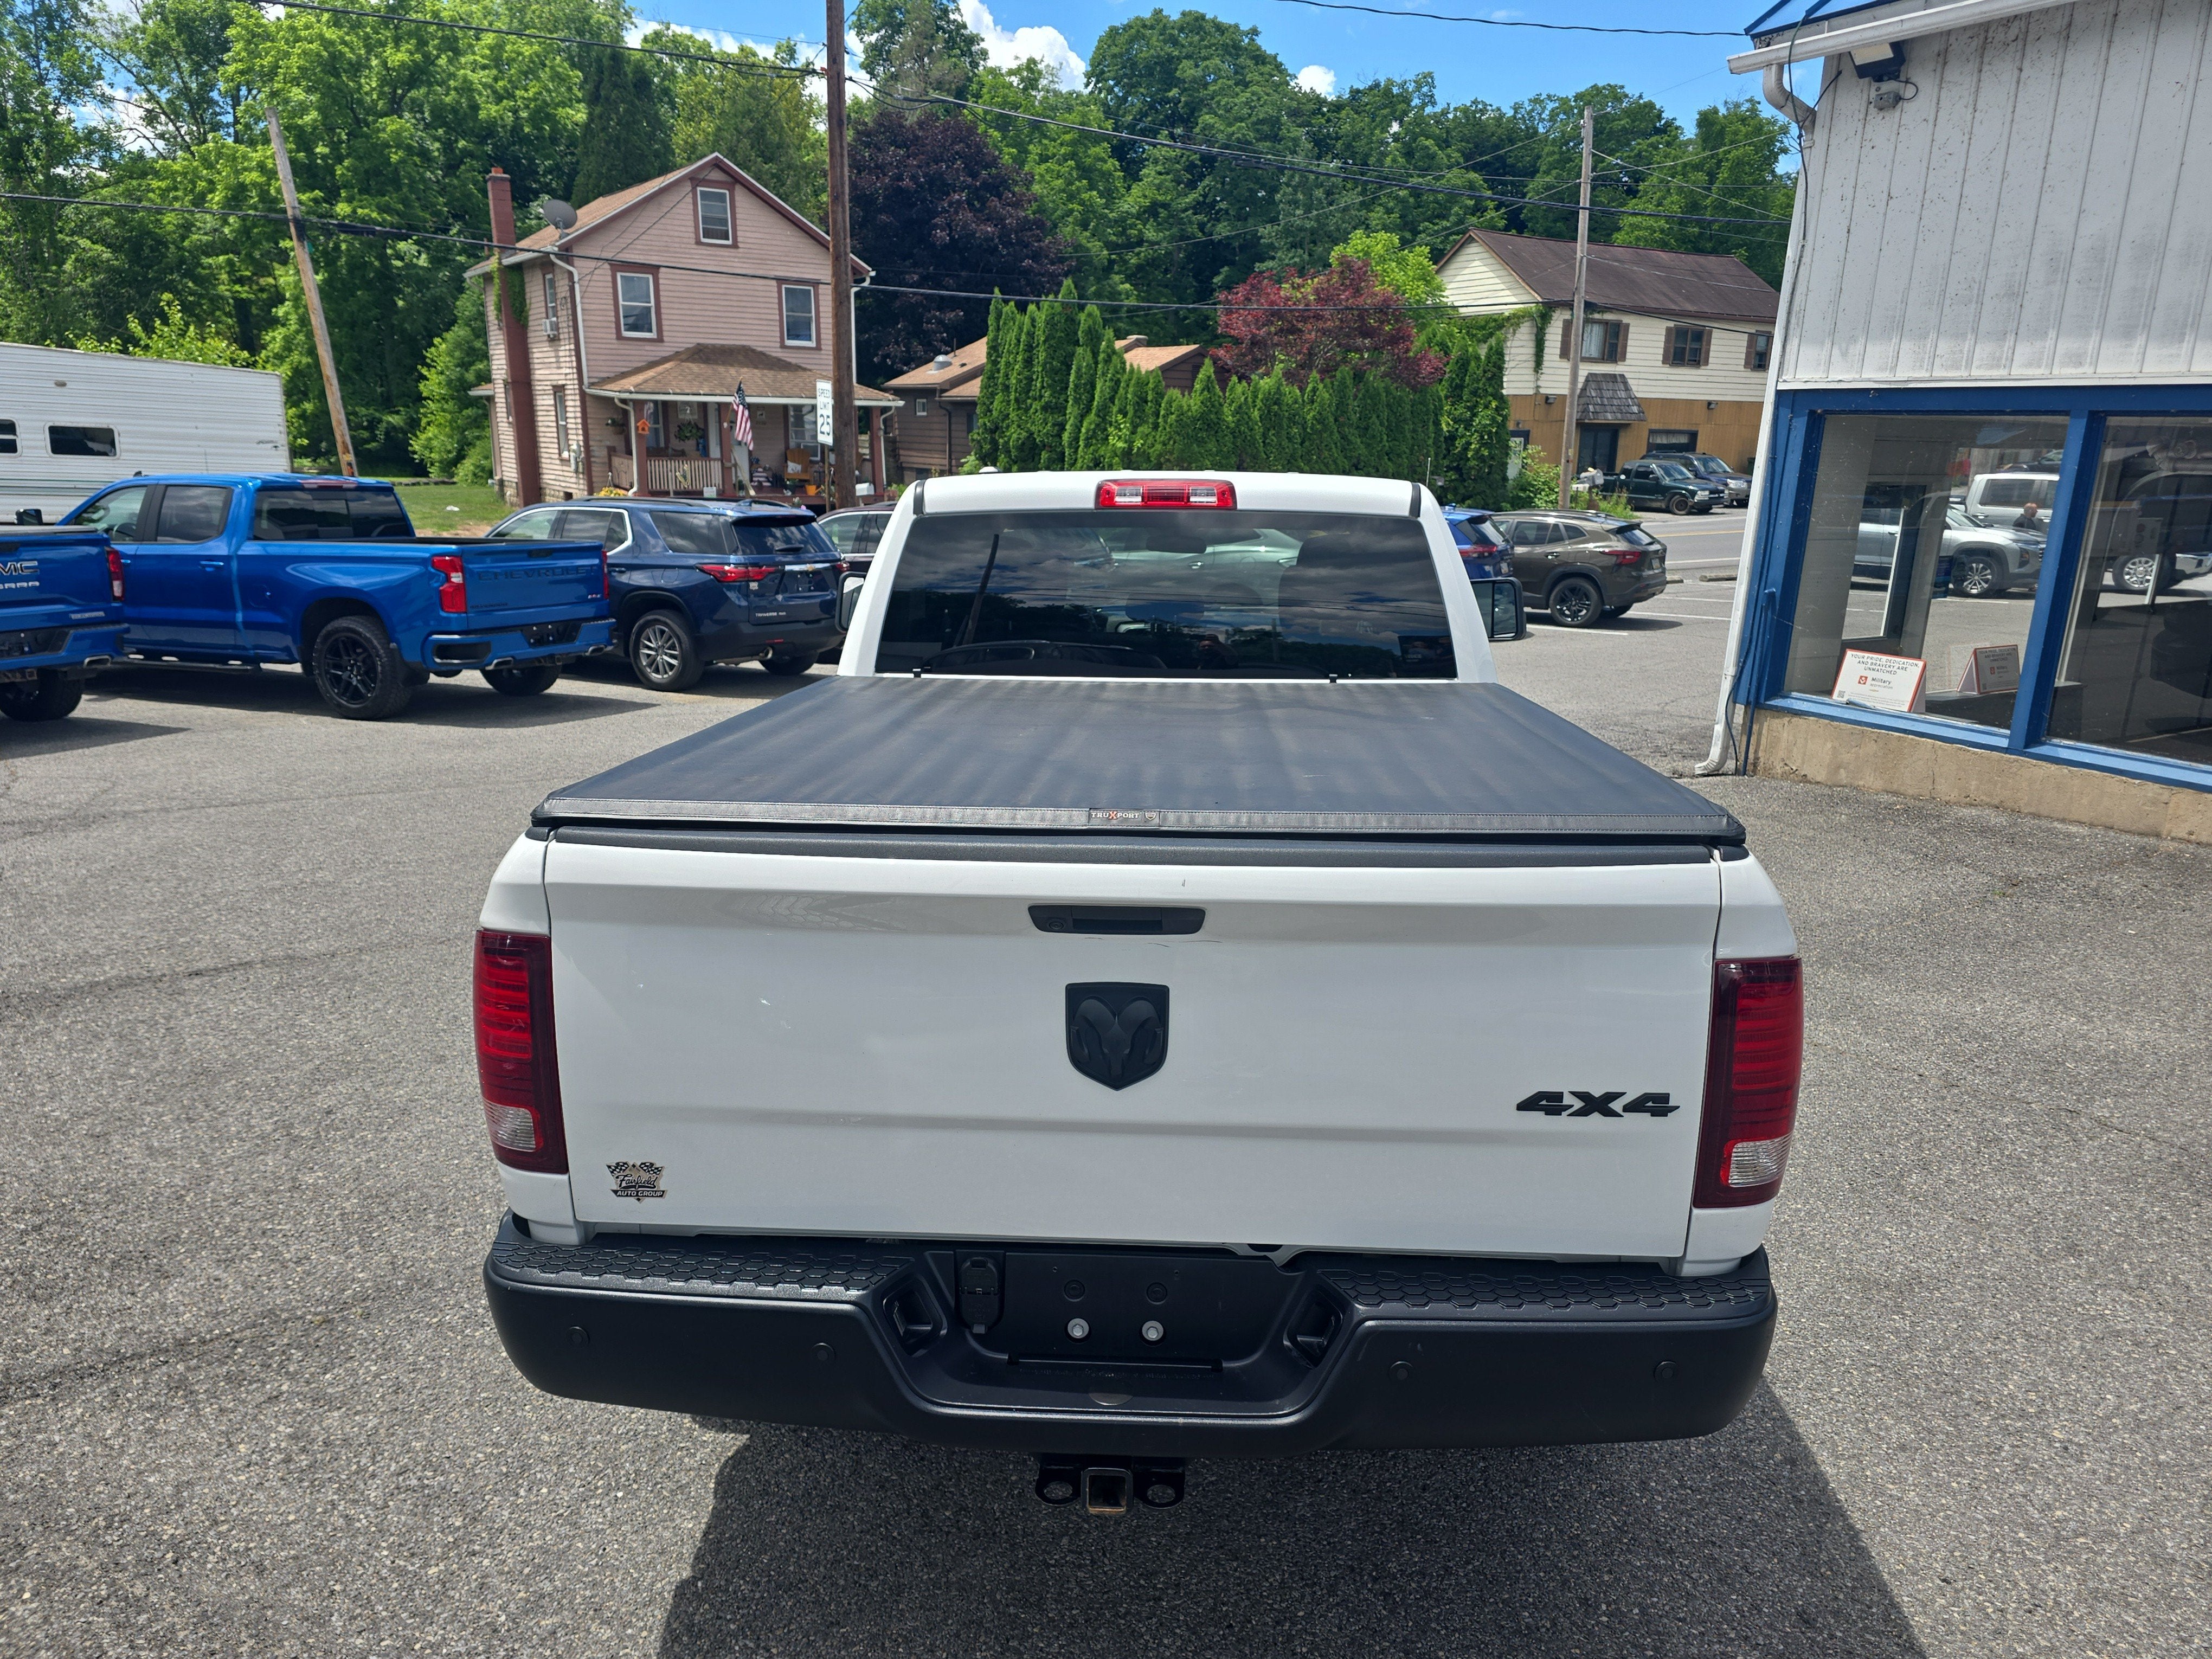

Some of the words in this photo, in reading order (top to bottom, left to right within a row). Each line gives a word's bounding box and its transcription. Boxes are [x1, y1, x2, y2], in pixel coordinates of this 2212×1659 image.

[819, 414, 831, 436] 25
[0, 561, 40, 575] MC
[478, 567, 596, 581] CHEVROLET
[1885, 658, 1919, 668] DEDICATION,
[1864, 666, 1897, 676] UNMATCHED
[615, 1174, 658, 1188] Fairfield
